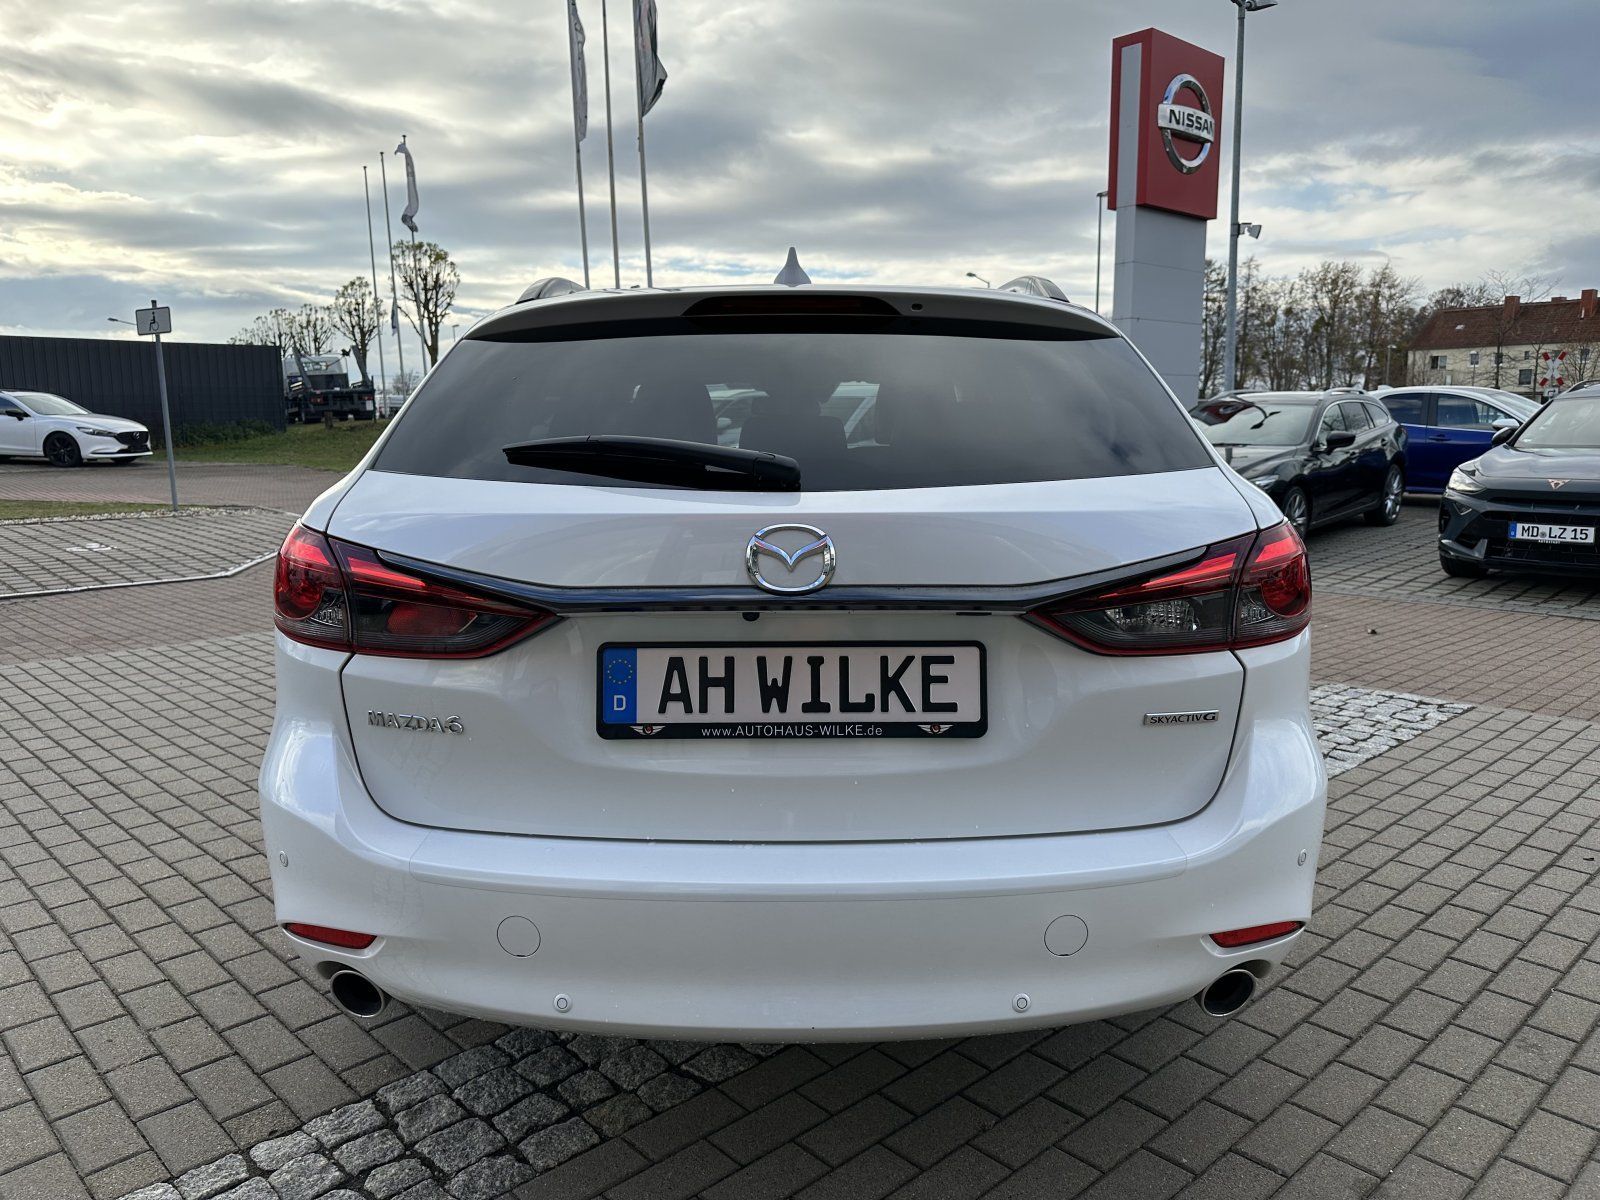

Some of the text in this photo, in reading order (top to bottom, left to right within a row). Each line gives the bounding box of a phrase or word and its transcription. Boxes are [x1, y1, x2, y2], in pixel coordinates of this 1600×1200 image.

[1521, 525, 1589, 541] MD LZ 15
[658, 655, 958, 714] AH WILKE
[613, 694, 627, 711] D
[367, 710, 465, 736] MAZDA6
[701, 724, 883, 737] www.AUTOHAUS-WILKE.de
